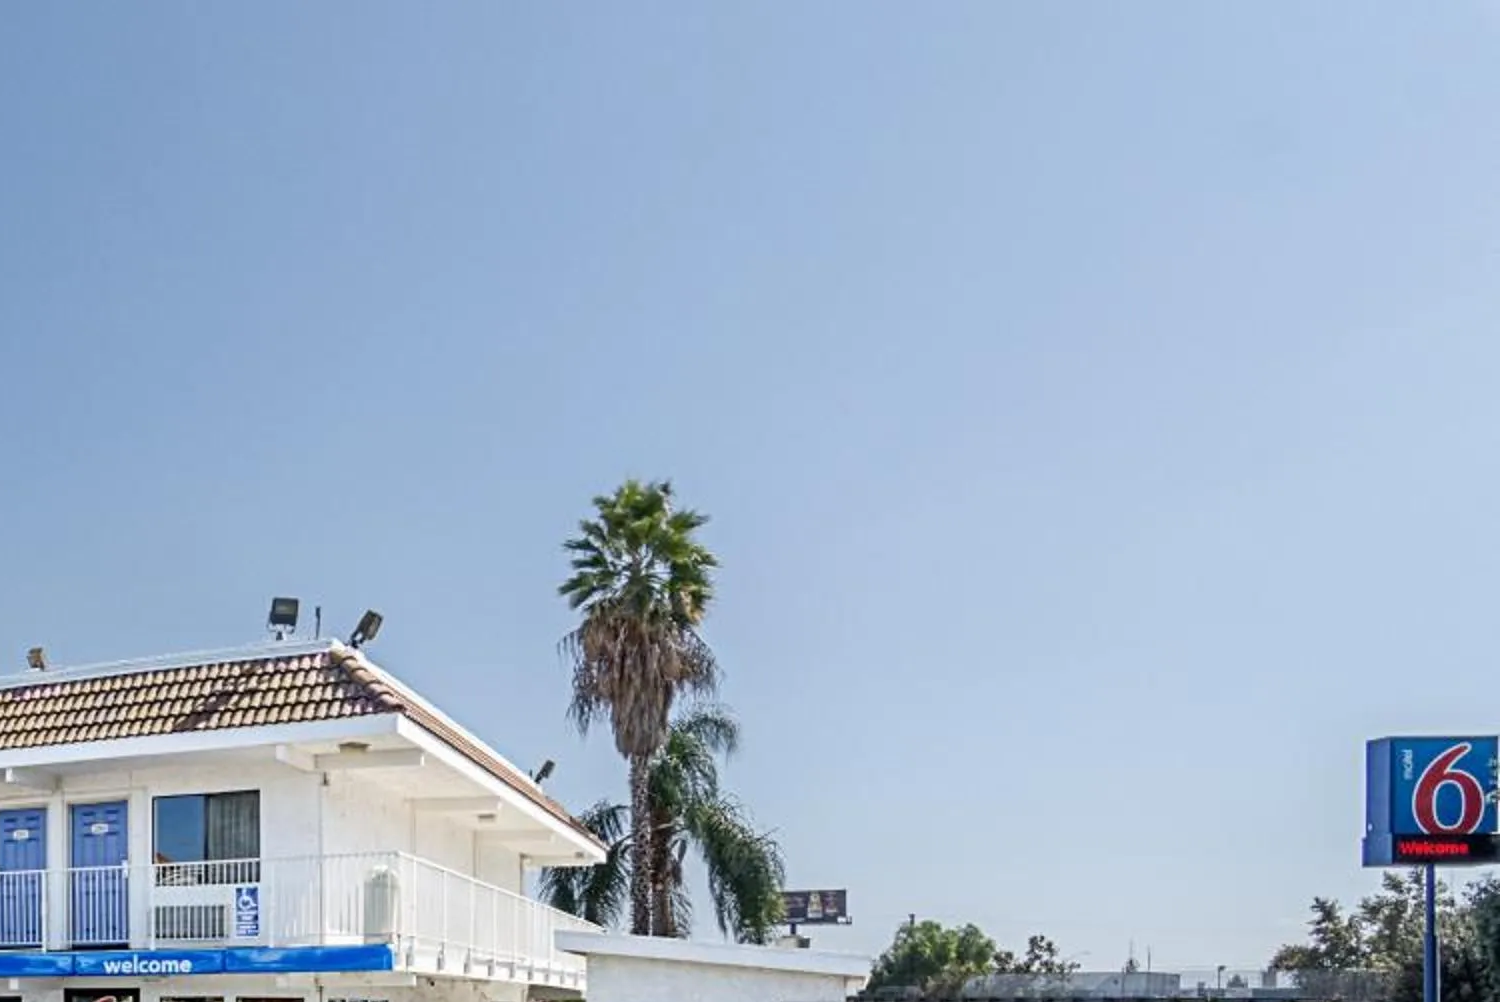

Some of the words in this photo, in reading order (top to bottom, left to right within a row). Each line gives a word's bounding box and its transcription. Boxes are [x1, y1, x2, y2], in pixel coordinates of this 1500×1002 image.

[1411, 741, 1484, 835] 6
[1399, 841, 1469, 855] Welcome
[103, 953, 192, 974] welcome
